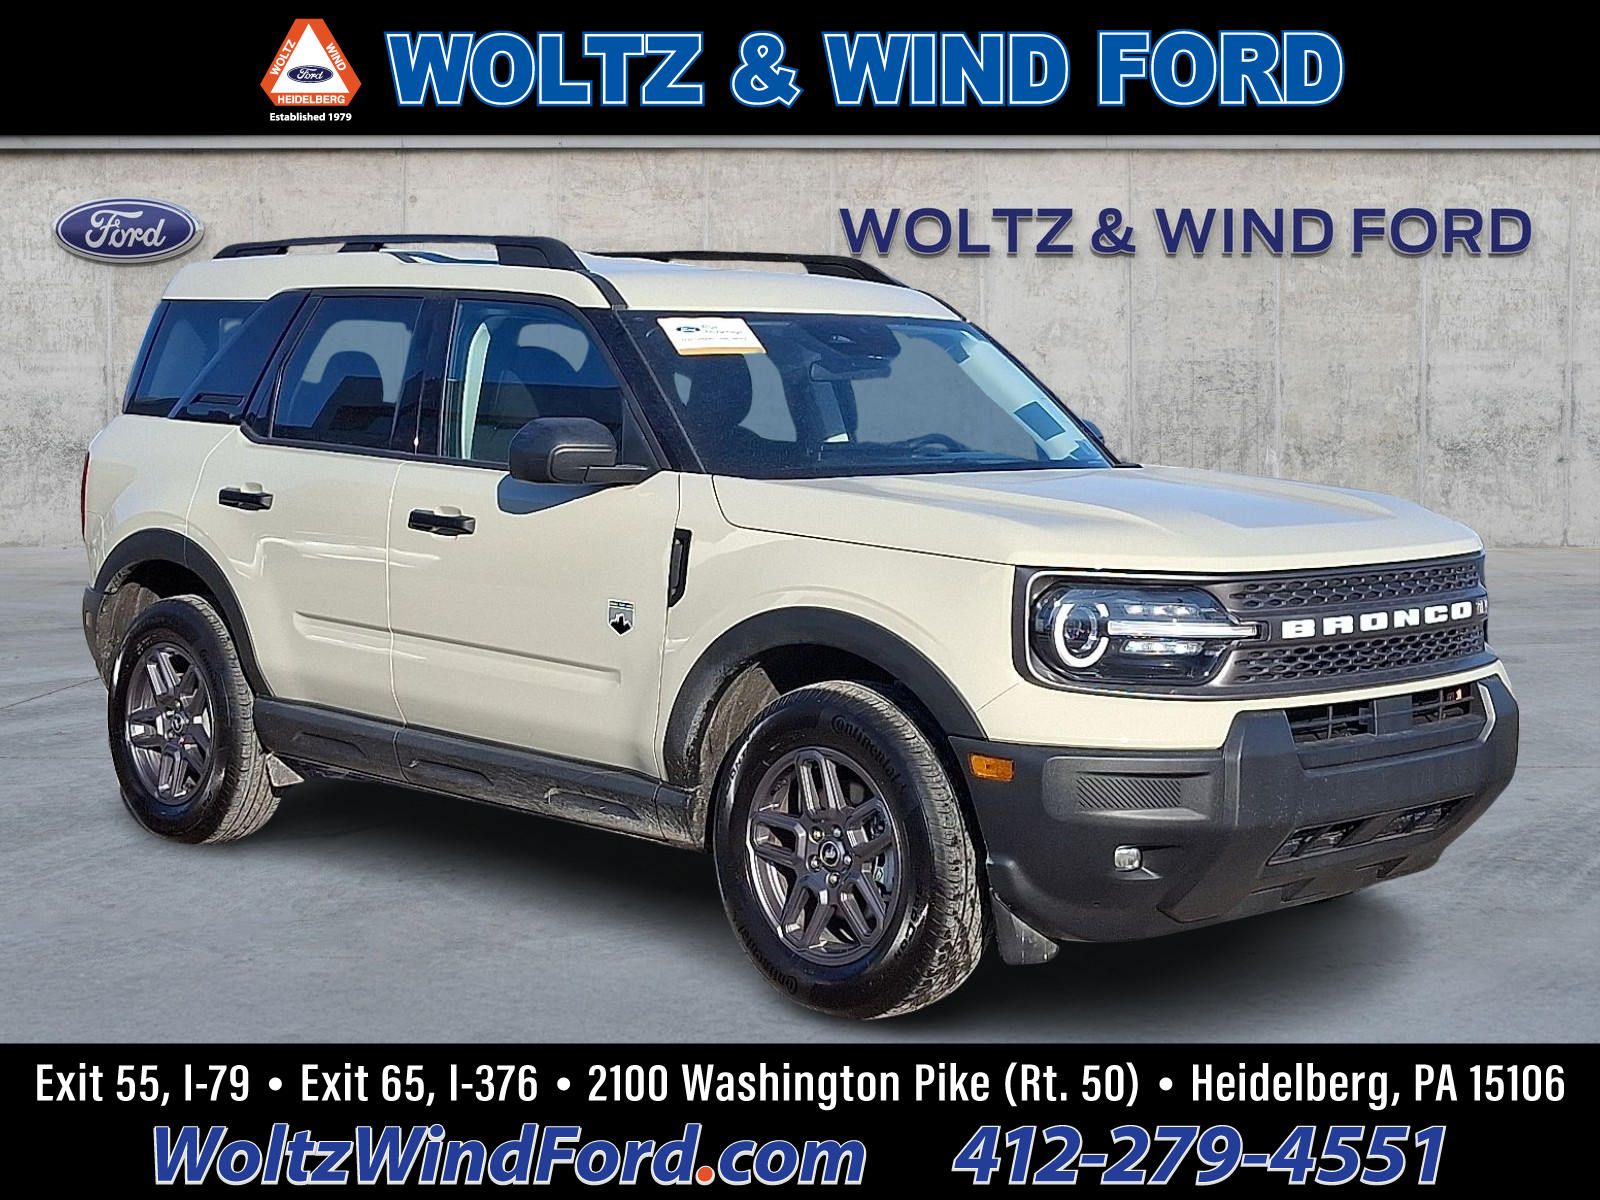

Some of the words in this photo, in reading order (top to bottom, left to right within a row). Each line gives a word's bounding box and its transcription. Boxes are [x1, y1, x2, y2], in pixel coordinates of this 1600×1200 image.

[85, 209, 166, 249] Ford
[840, 207, 1074, 255] WOLTZ
[1090, 207, 1137, 255] &
[1155, 207, 1334, 255] WIND
[1352, 207, 1532, 255] FORD
[1281, 601, 1472, 640] BRONCO
